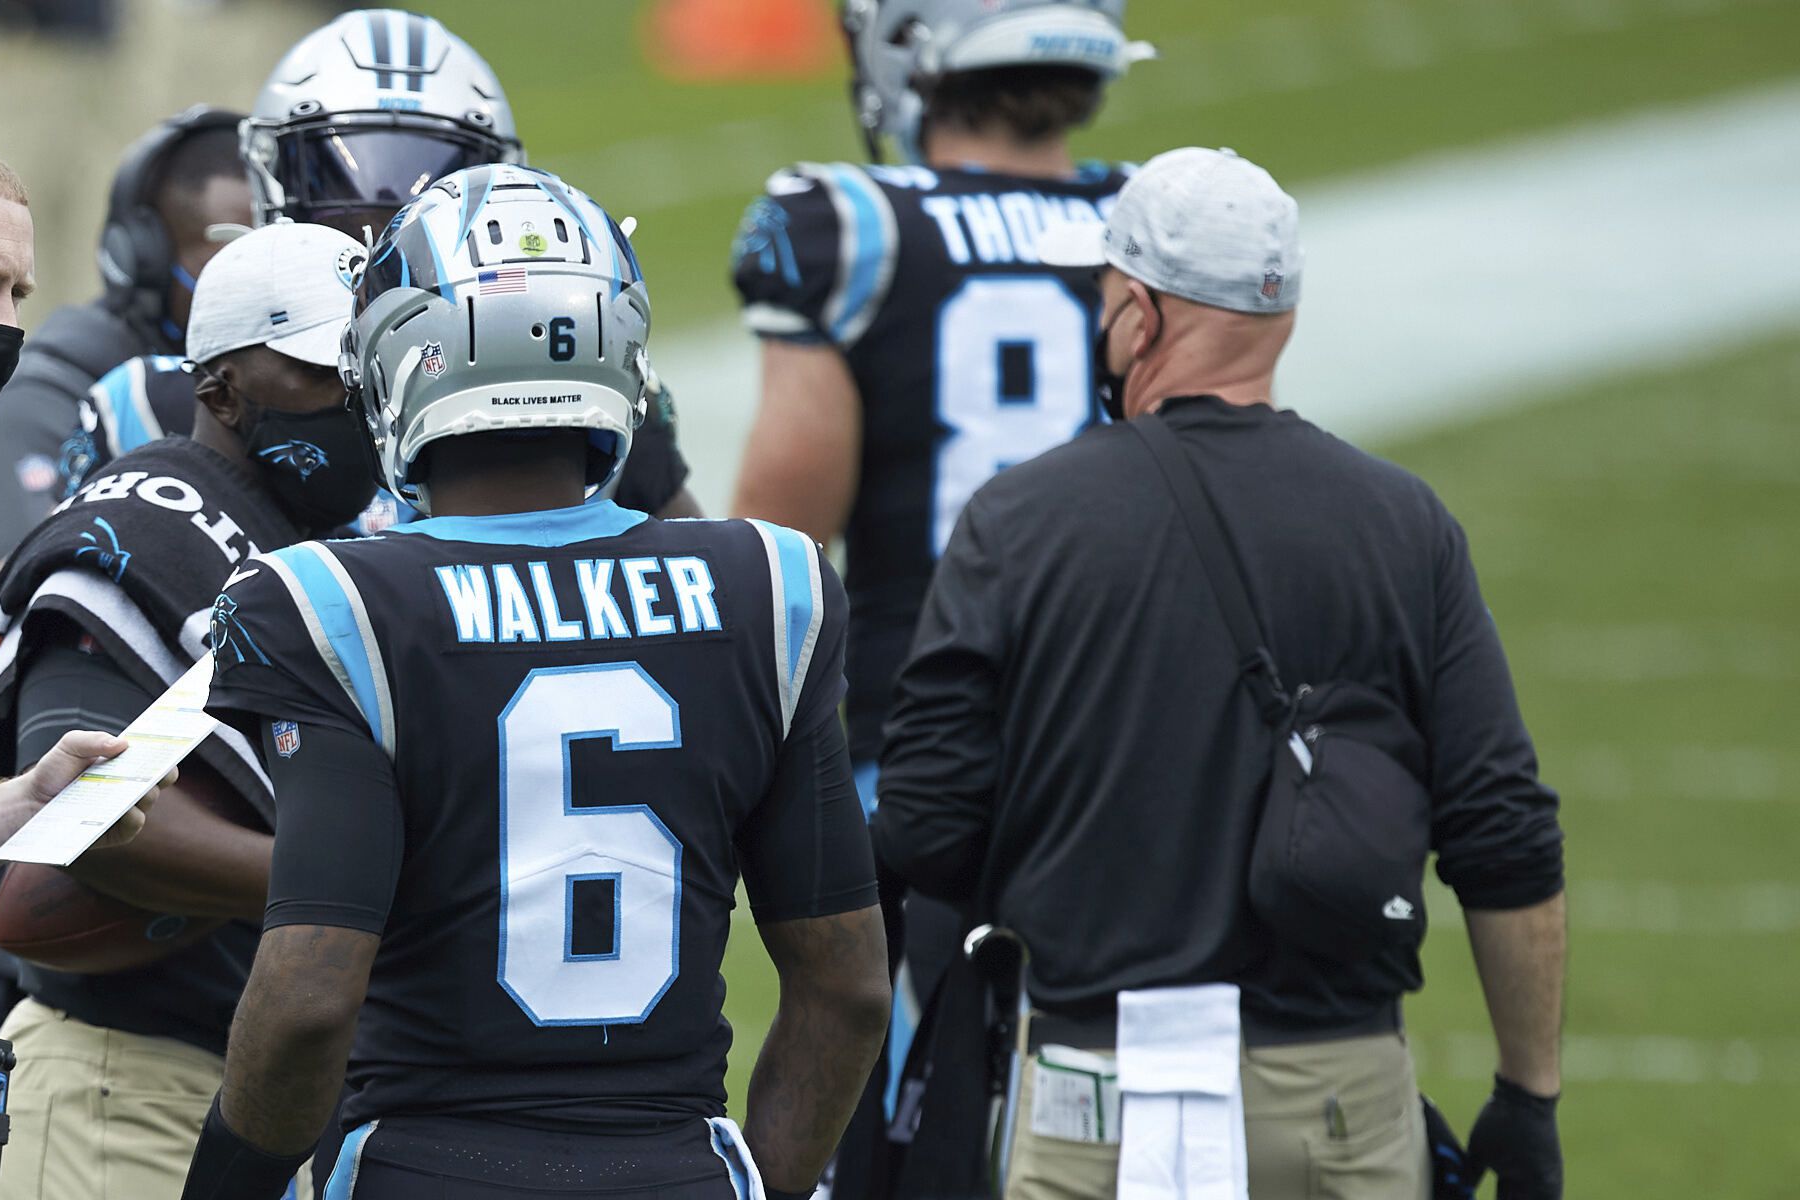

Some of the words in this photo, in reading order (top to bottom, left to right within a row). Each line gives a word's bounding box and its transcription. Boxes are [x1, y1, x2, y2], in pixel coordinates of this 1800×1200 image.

[549, 316, 576, 363] 6
[491, 397, 520, 405] BLACK
[522, 396, 548, 405] LIVES
[549, 394, 582, 404] MATTER
[434, 556, 723, 643] WALKER
[277, 732, 297, 752] NFL
[497, 661, 683, 1028] 6
